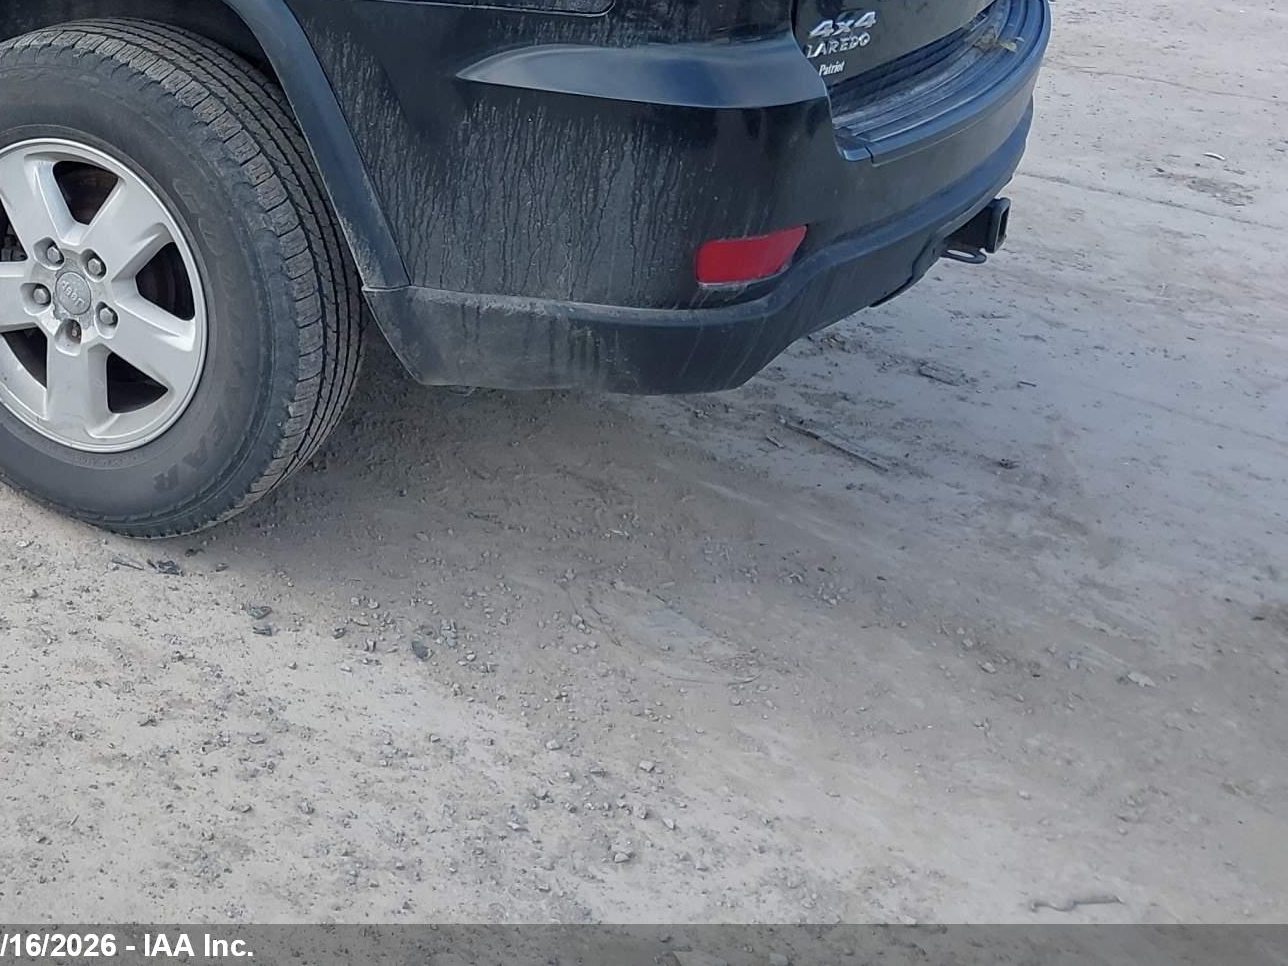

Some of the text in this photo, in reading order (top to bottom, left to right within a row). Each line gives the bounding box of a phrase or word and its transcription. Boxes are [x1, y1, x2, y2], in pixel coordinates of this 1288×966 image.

[809, 11, 877, 38] 4x4
[806, 32, 871, 59] LAREDO
[818, 61, 845, 76] Patriot
